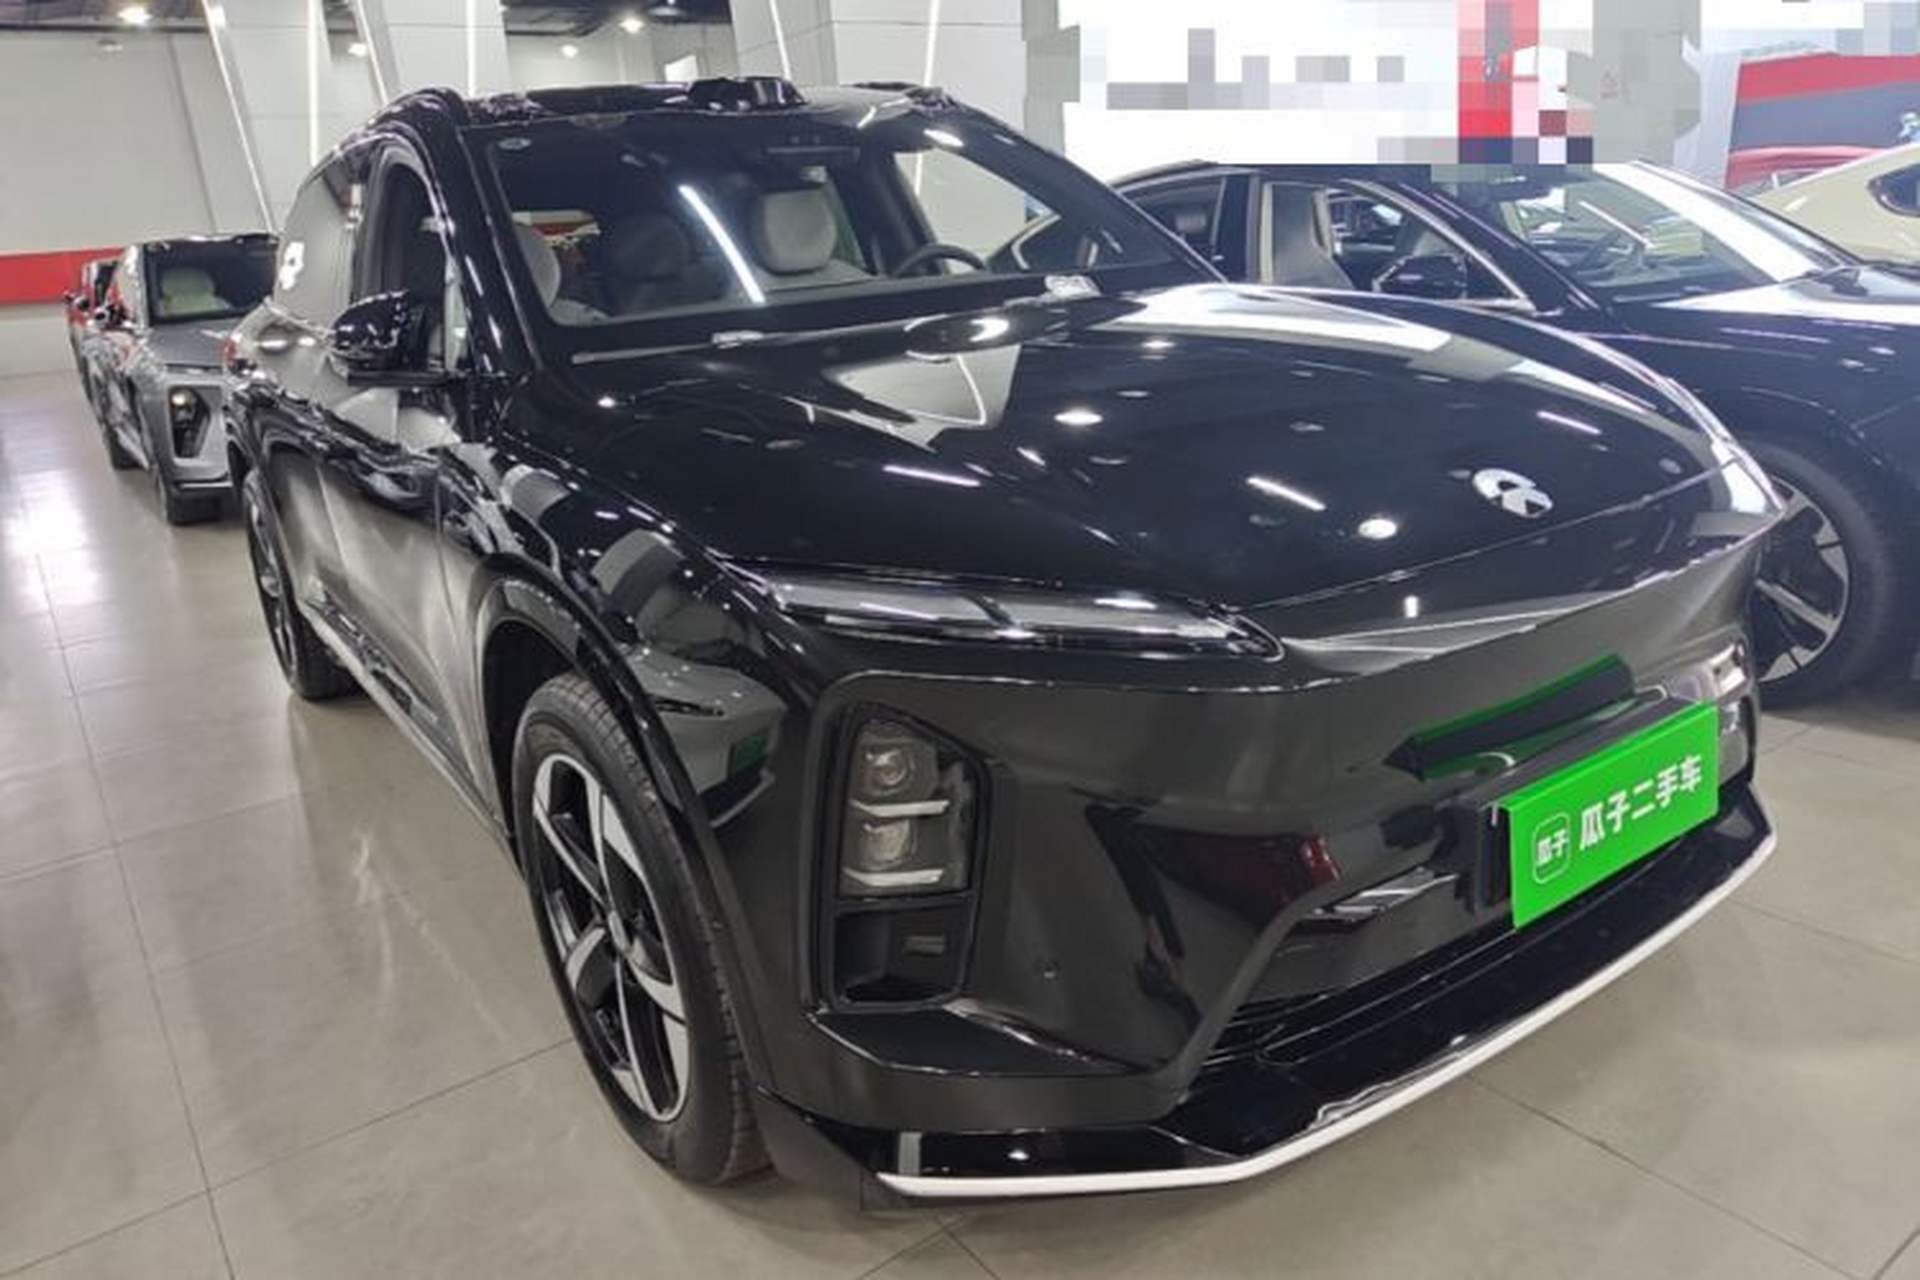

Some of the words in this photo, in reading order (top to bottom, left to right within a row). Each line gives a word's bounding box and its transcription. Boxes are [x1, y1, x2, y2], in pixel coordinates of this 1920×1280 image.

[1579, 754, 1702, 850] 瓜子二手车
